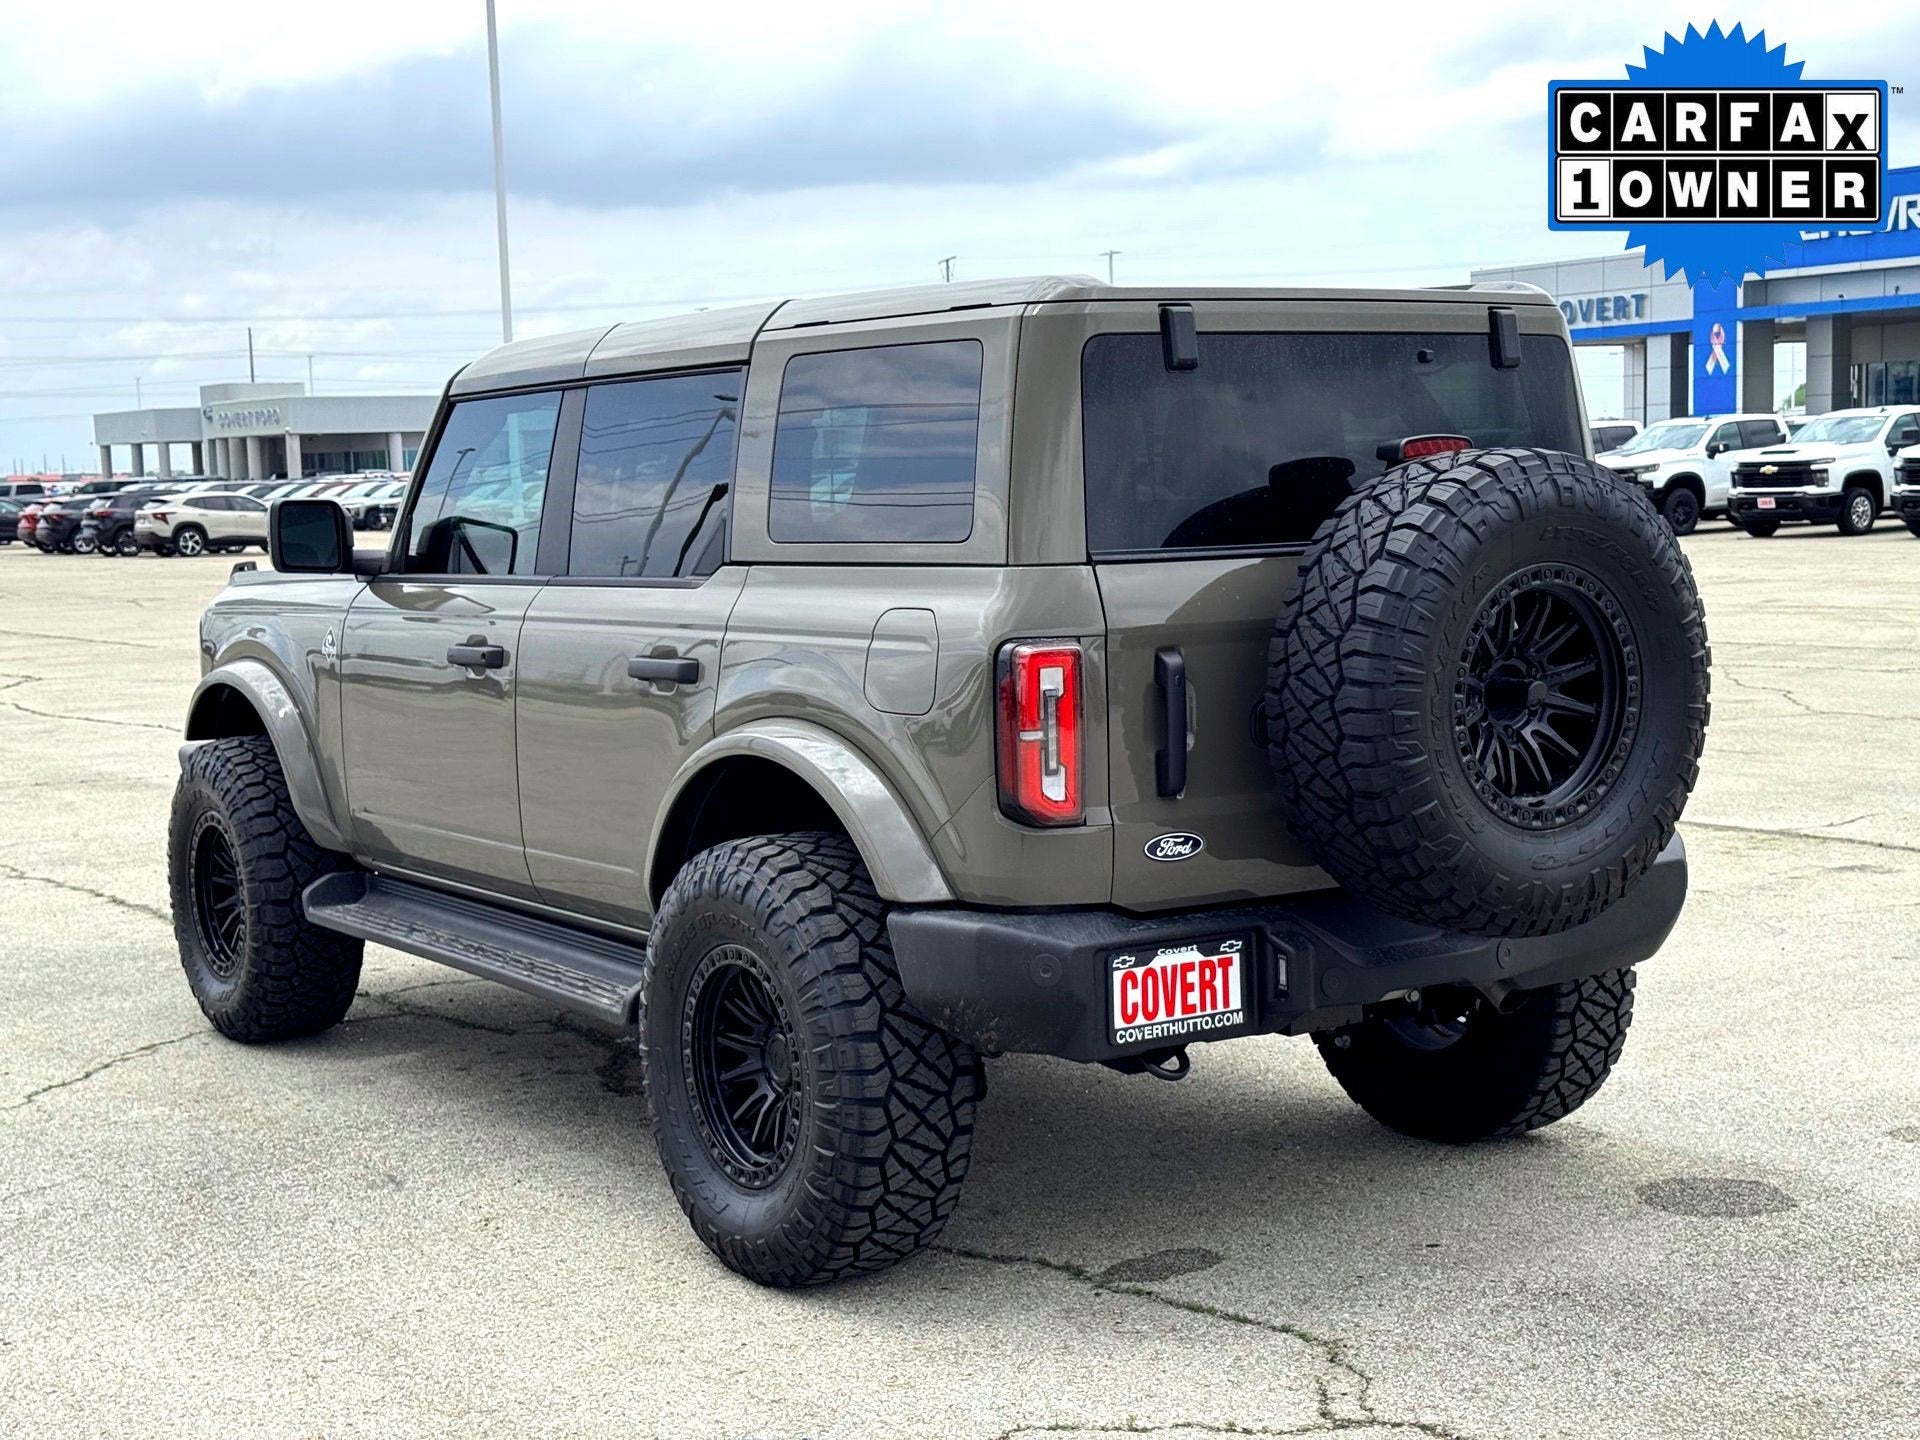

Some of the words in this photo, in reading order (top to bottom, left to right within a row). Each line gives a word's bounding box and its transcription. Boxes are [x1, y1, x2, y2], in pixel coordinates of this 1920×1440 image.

[1560, 293, 1648, 325] OVERT
[1156, 837, 1194, 857] Ford
[1157, 945, 1198, 956] Covert
[1120, 956, 1233, 1025] COVERT
[1116, 1011, 1243, 1044] COVERTHUTTO.COM
